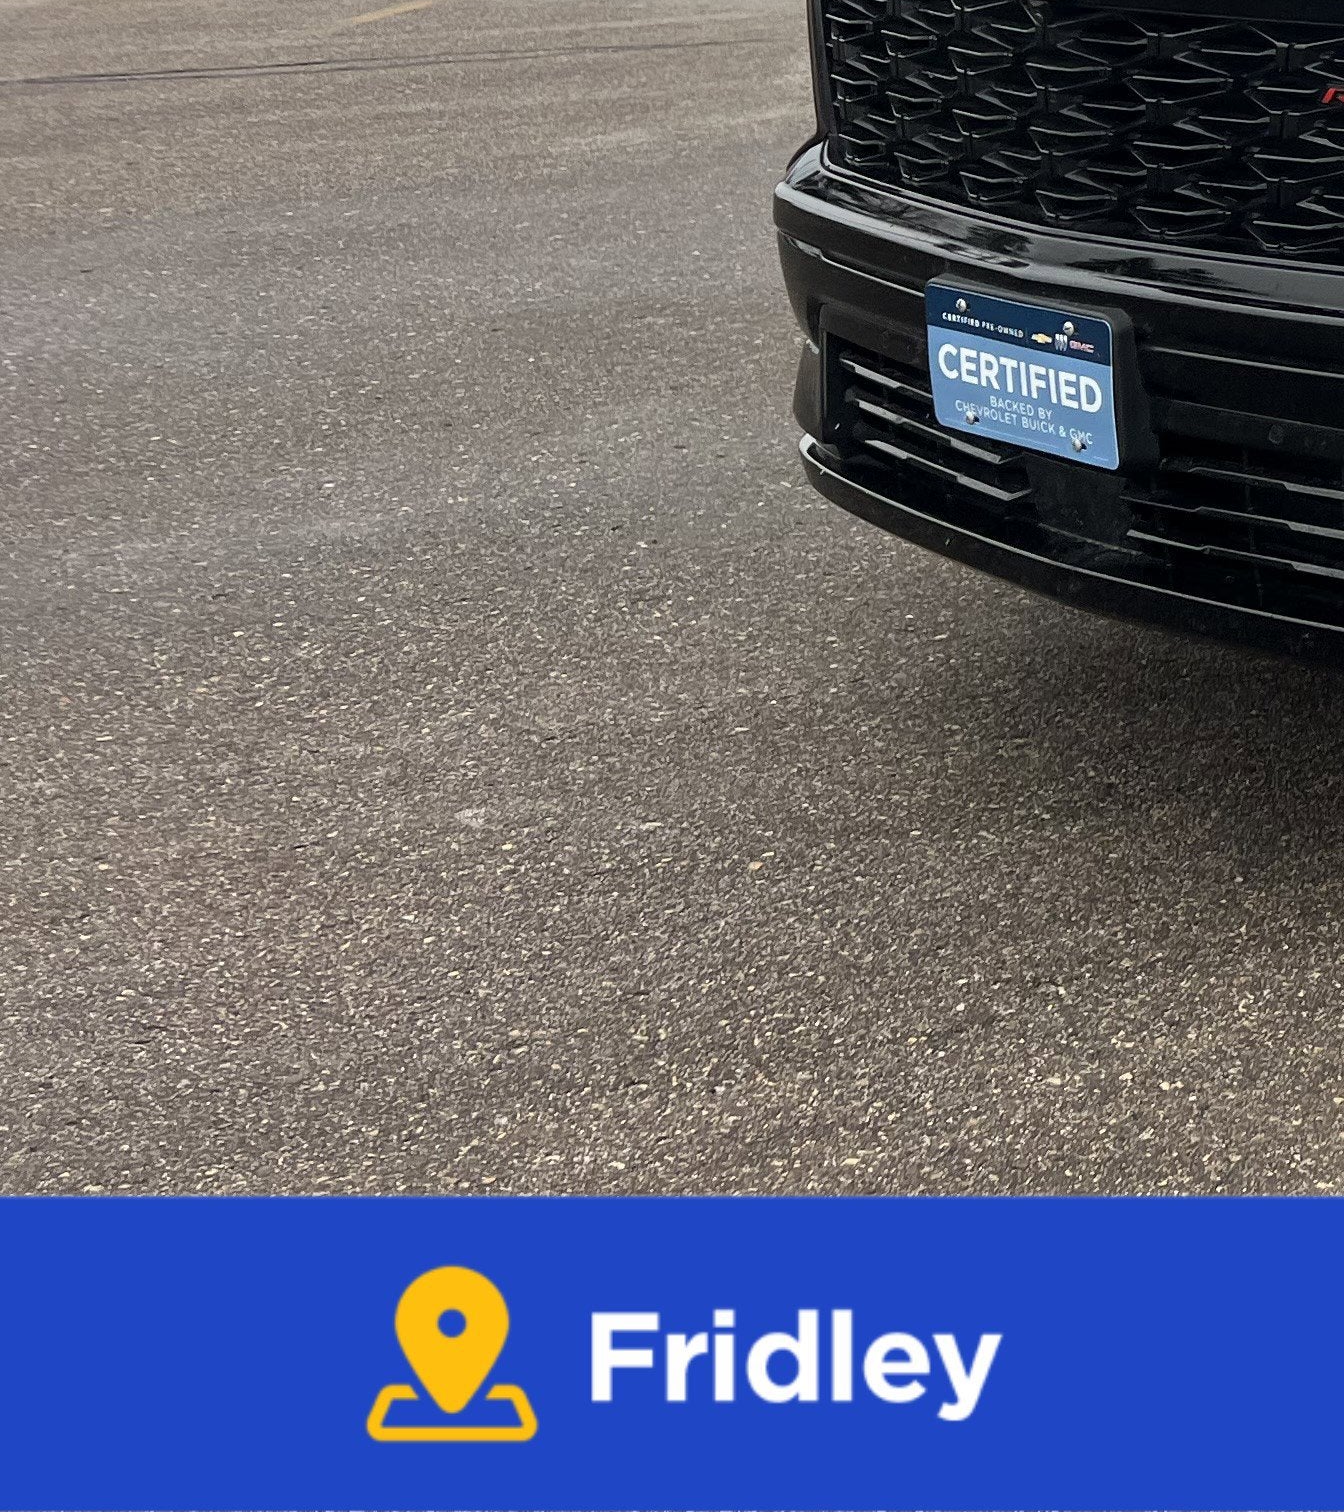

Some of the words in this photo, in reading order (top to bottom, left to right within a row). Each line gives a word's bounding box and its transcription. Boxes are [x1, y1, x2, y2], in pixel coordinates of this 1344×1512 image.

[942, 312, 980, 327] CERTIFIED
[938, 343, 1102, 413] CERTIFIED
[955, 398, 1018, 427] CHEVROLET
[1021, 413, 1056, 435] BUICK
[1058, 425, 1066, 438] &
[1069, 427, 1093, 445] GMC
[989, 394, 1035, 417] BACKED
[1037, 406, 1053, 421] BY
